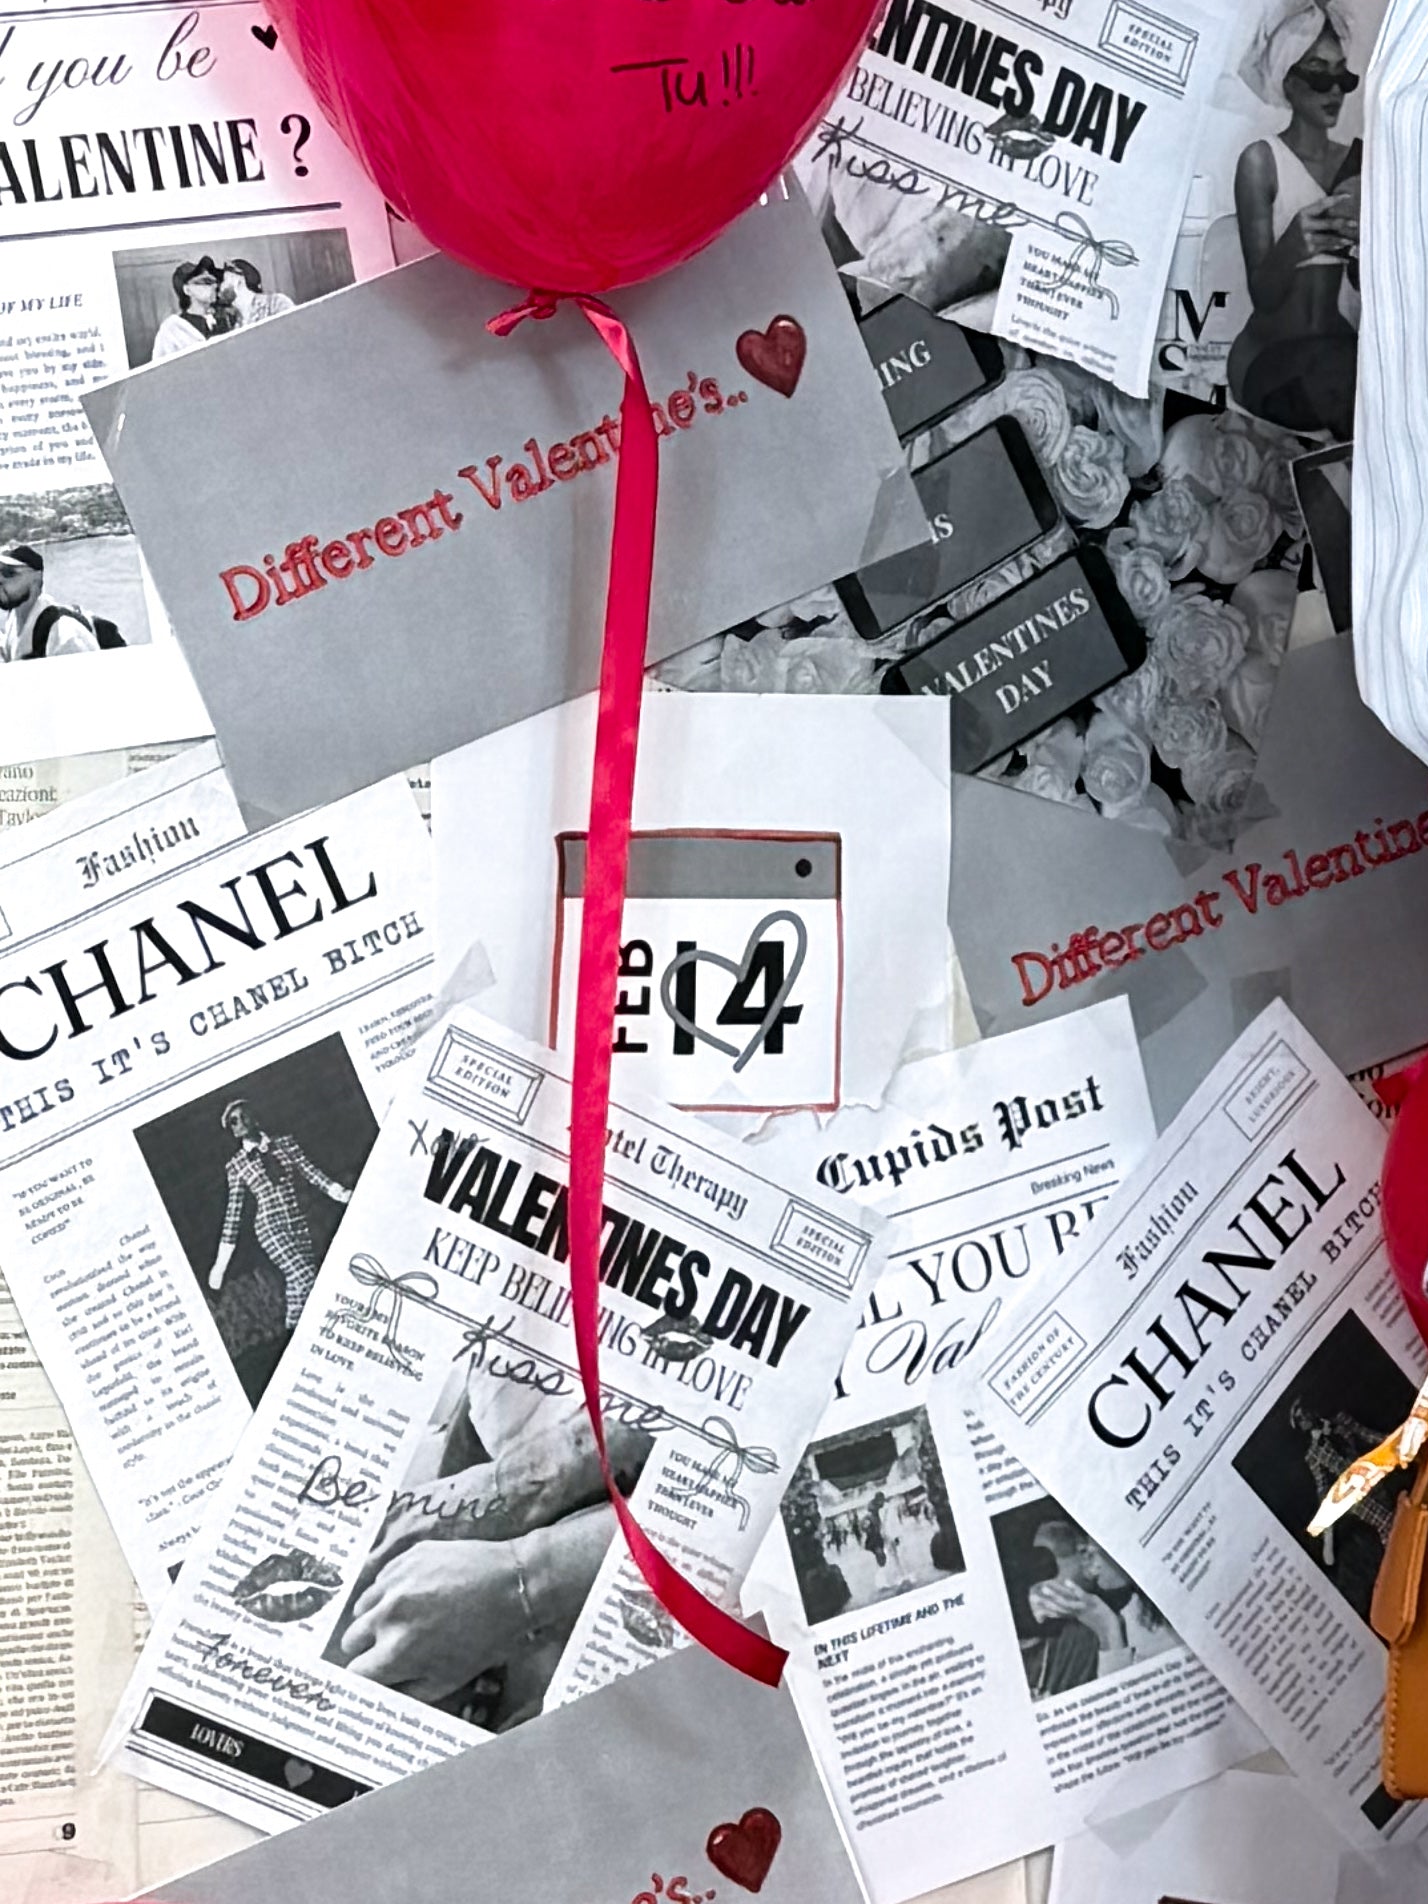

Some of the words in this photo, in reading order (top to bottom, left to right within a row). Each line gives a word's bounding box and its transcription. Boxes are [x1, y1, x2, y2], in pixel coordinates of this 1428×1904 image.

[13, 46, 137, 128] you
[156, 11, 218, 83] be
[1041, 69, 1148, 167] DAY
[848, 66, 984, 158] BELIEVING
[1025, 148, 1099, 209] LOVE
[219, 490, 464, 622] Different
[920, 588, 1093, 698] VALENTINES
[993, 660, 1055, 717] DAY
[75, 814, 202, 891] Fashion
[0, 835, 378, 1062] CHANEL
[663, 936, 803, 1056] 14
[1010, 890, 1229, 1008] Different
[0, 1077, 75, 1134] THIS
[97, 1031, 172, 1086] IT'S
[190, 968, 309, 1037] CHANEL
[328, 909, 426, 969] BITCH
[647, 1144, 749, 1223] Therapy
[815, 1115, 986, 1194] Cupids
[1000, 1073, 1106, 1151] Post
[1029, 1168, 1084, 1197] Breaking
[908, 1225, 1034, 1305] YOU
[1119, 1179, 1201, 1282] Fashion
[422, 1227, 502, 1286] KEEP
[679, 1353, 754, 1412] LOVE
[703, 1258, 812, 1370] DAY
[1087, 1146, 1347, 1451] CHANEL
[1123, 1445, 1183, 1512] THIS
[1239, 1269, 1320, 1370] CHANEL
